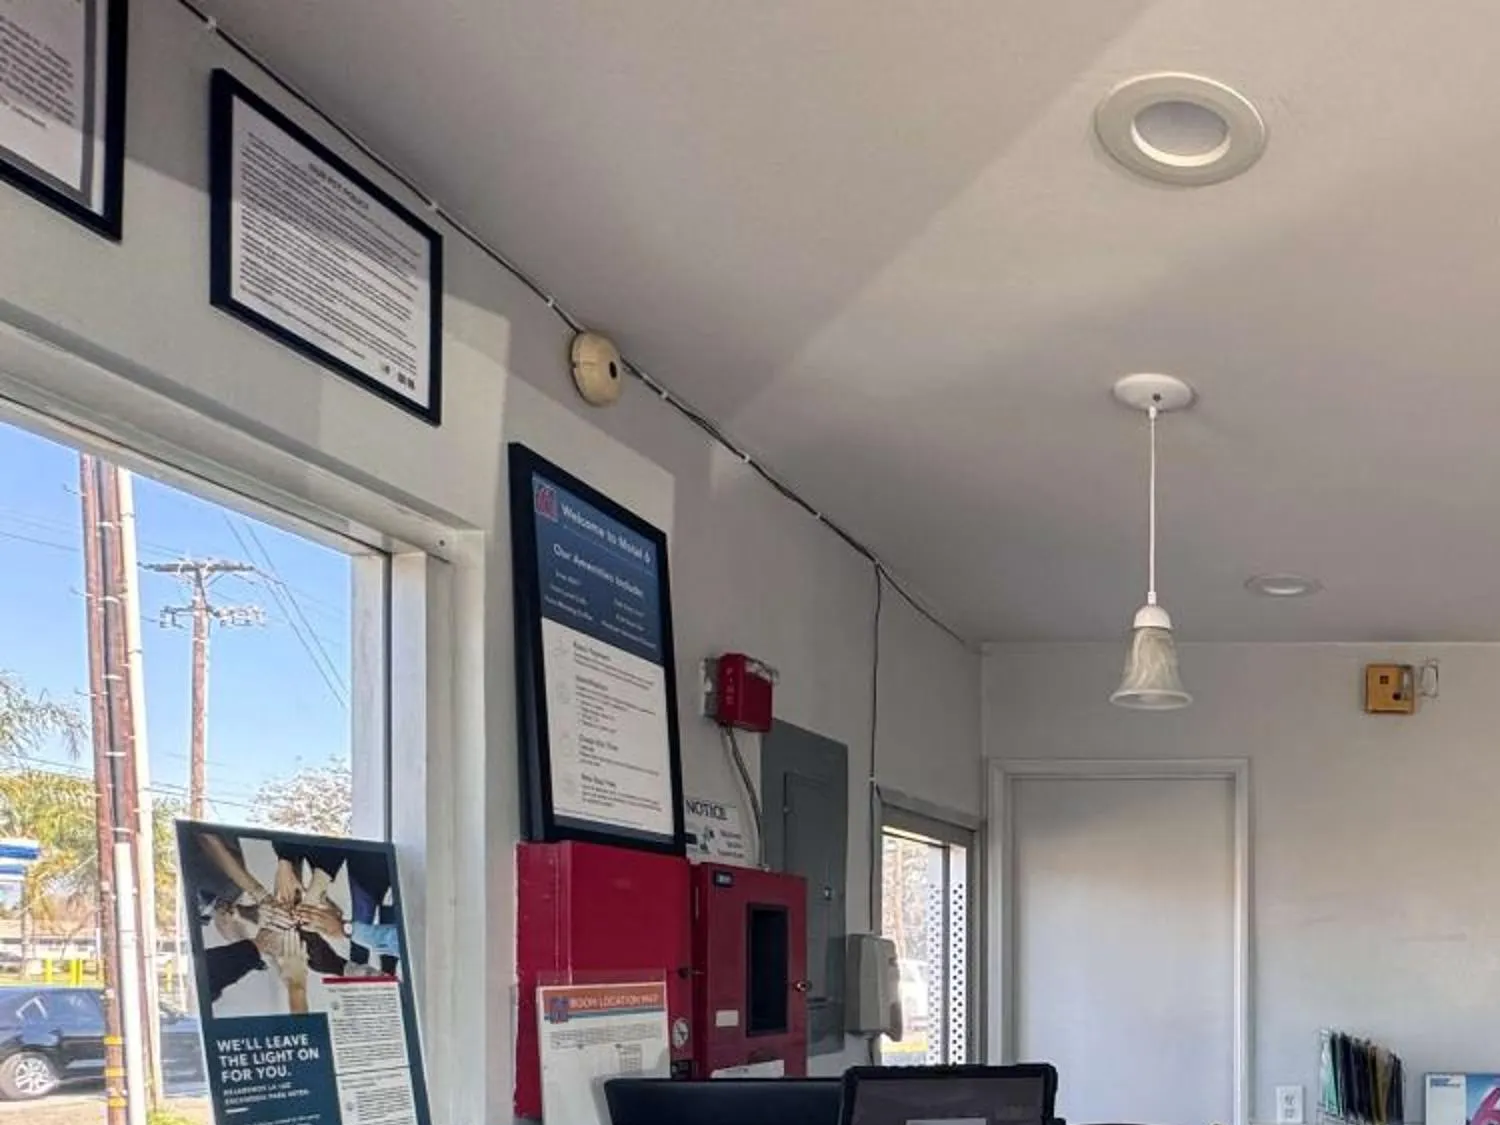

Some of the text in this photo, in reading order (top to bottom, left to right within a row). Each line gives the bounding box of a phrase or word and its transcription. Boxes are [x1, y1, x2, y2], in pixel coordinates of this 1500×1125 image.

[216, 1032, 310, 1053] WE'LL LEAVE
[218, 1047, 320, 1069] THE LIGHT ON
[221, 1063, 293, 1084] FOR YOU.
